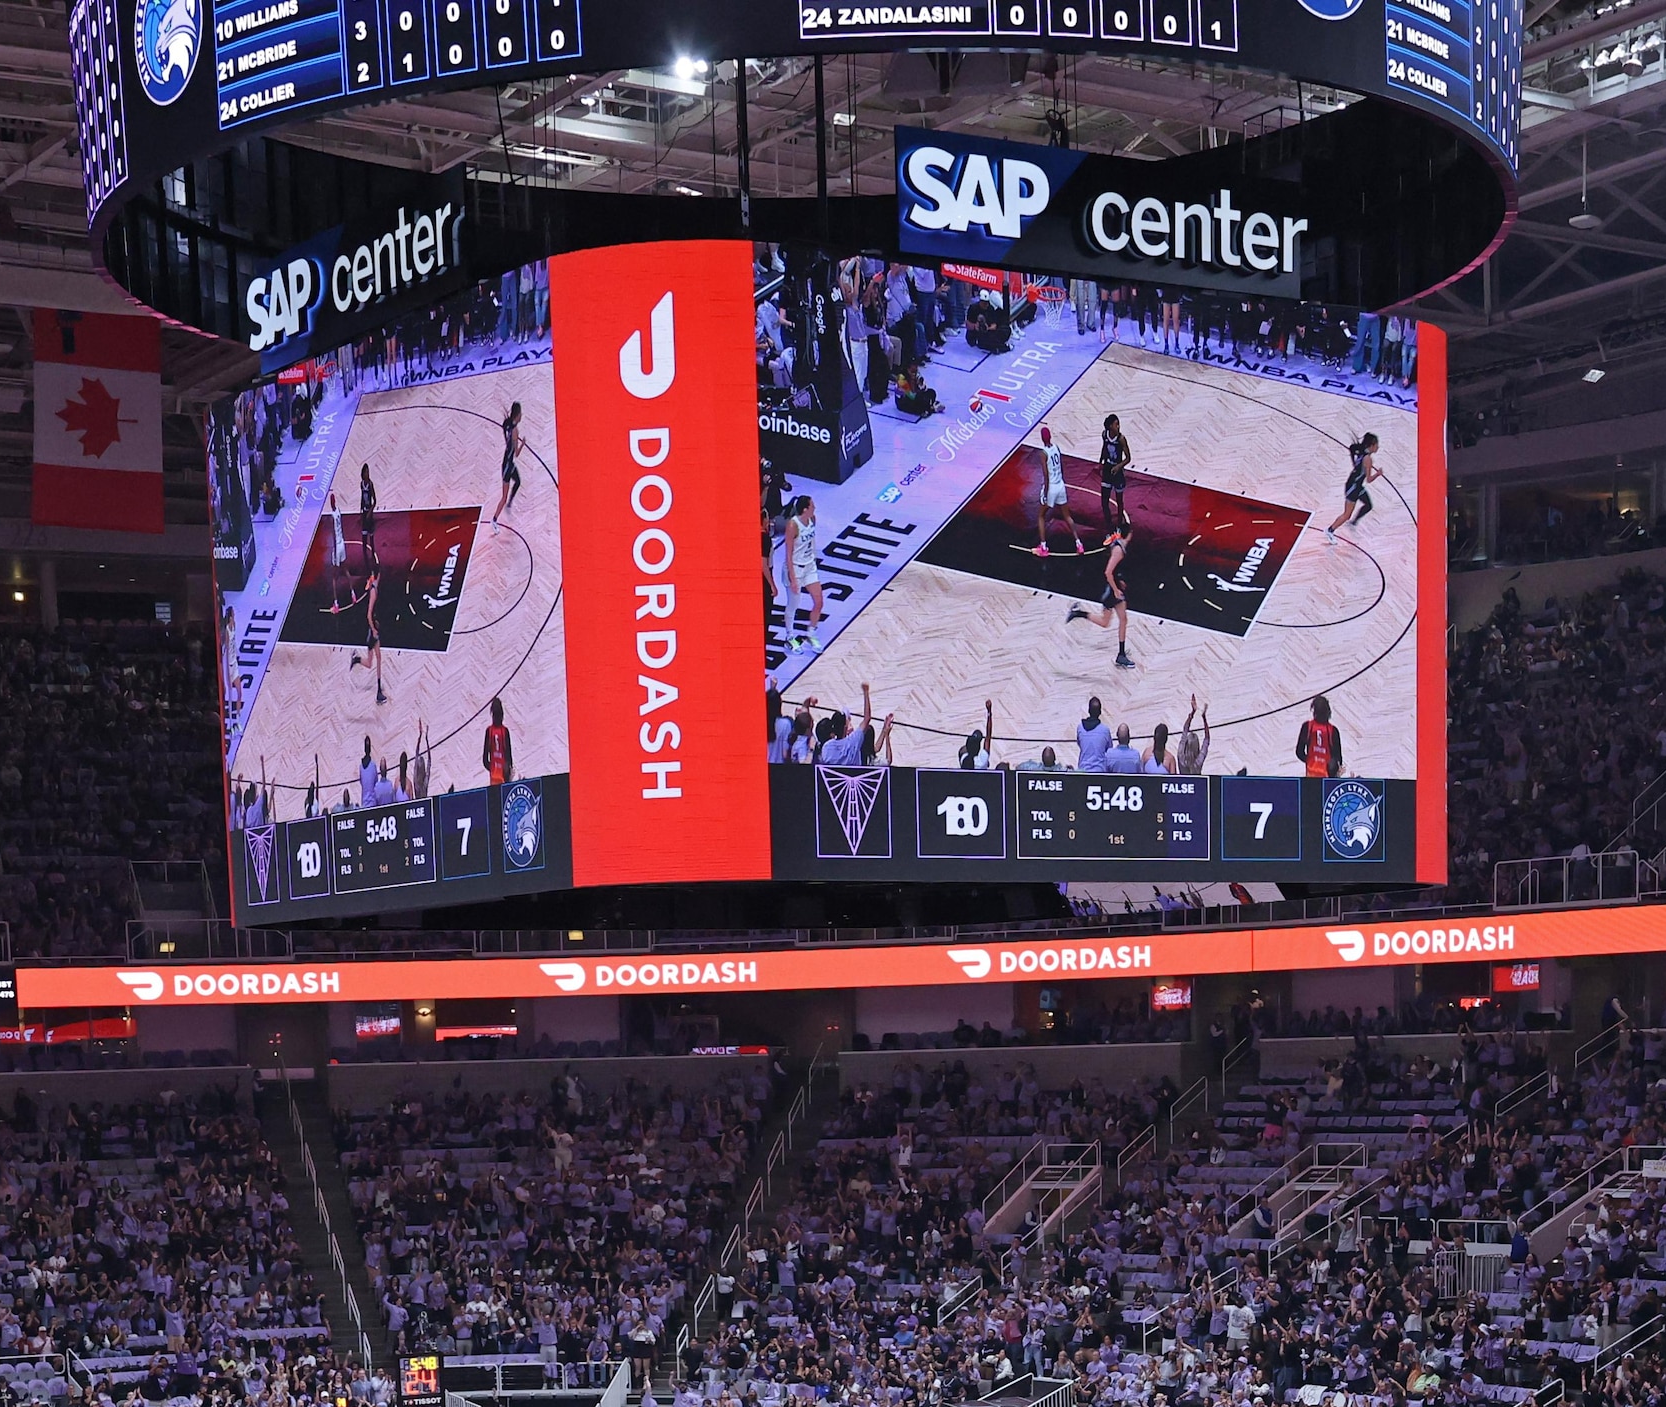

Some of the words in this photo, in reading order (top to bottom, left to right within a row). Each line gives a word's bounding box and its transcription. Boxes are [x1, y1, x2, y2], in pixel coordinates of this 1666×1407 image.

[215, 22, 234, 42] 10
[235, 1, 299, 33] WILLIAMS
[803, 8, 832, 29] 24
[837, 5, 971, 26] ZANDALASINI
[1010, 5, 1024, 26] 0
[1063, 6, 1077, 28] 0
[1114, 10, 1128, 31] 0
[1164, 15, 1177, 35] 0
[1211, 21, 1221, 41] 1
[217, 59, 235, 81] 21
[237, 40, 297, 72] MCBRIDE
[355, 21, 367, 40] 3
[400, 11, 413, 31] 0
[447, 3, 460, 22] 0
[1387, 19, 1403, 41] 21
[1406, 28, 1449, 59] MCBRIDE
[1476, 63, 1482, 82] 3
[219, 100, 238, 121] 24
[240, 82, 295, 113] COLLIER
[357, 62, 369, 83] 2
[403, 53, 413, 73] 1
[449, 44, 462, 64] 0
[499, 37, 512, 57] 0
[551, 29, 564, 50] 0
[1388, 59, 1405, 81] 24
[1407, 67, 1448, 97] COLLIER
[1476, 101, 1483, 120] 2
[907, 145, 1051, 240] SAP
[1091, 188, 1308, 273] center
[246, 258, 311, 351] SAP
[332, 202, 452, 313] center
[955, 263, 997, 285] StateFarm
[815, 293, 826, 335] Google
[409, 362, 475, 384] WNBA
[992, 339, 1063, 393] ULTRA
[1194, 352, 1311, 384] WNBA
[305, 411, 338, 472] ULTRA
[757, 412, 831, 445] oinbase
[926, 403, 997, 463] Michelob
[1050, 454, 1060, 467] 10
[438, 543, 462, 598] WNBA
[818, 511, 917, 603] STATE
[1233, 537, 1275, 584] WNBA
[629, 427, 683, 799] DOORDASH
[238, 607, 279, 690] STATE
[1027, 780, 1064, 793] FALSE
[1085, 785, 1144, 813] 5:48
[1161, 782, 1195, 795] FALSE
[336, 818, 355, 832] FALSE
[405, 806, 425, 820] FALSE
[1030, 811, 1053, 823] TOL
[1068, 811, 1076, 823] 5
[1156, 812, 1165, 824] 5
[1171, 813, 1193, 825] TOL
[1249, 802, 1274, 840] 7
[365, 815, 398, 844] 5:48
[403, 838, 410, 850] 5
[412, 836, 425, 849] TOL
[456, 817, 473, 856] 7
[1032, 828, 1053, 841] FLS
[1068, 829, 1076, 841] 0
[1107, 833, 1125, 846] 1st
[1156, 830, 1165, 842] 2
[1172, 830, 1193, 842] FLS
[339, 846, 351, 860] TOL
[357, 845, 363, 857] 5
[404, 855, 410, 867] 2
[413, 853, 426, 866] FLS
[340, 863, 352, 876] FLS
[358, 862, 364, 874] 0
[379, 863, 389, 875] 1st
[1373, 925, 1515, 957] DOORDASH
[1000, 945, 1152, 974] DOORDASH
[173, 971, 340, 998] DOORDASH
[595, 961, 758, 989] DOORDASH
[410, 1356, 438, 1371] 5:48
[405, 1370, 437, 1395] 24
[415, 1397, 442, 1406] TISSOT
